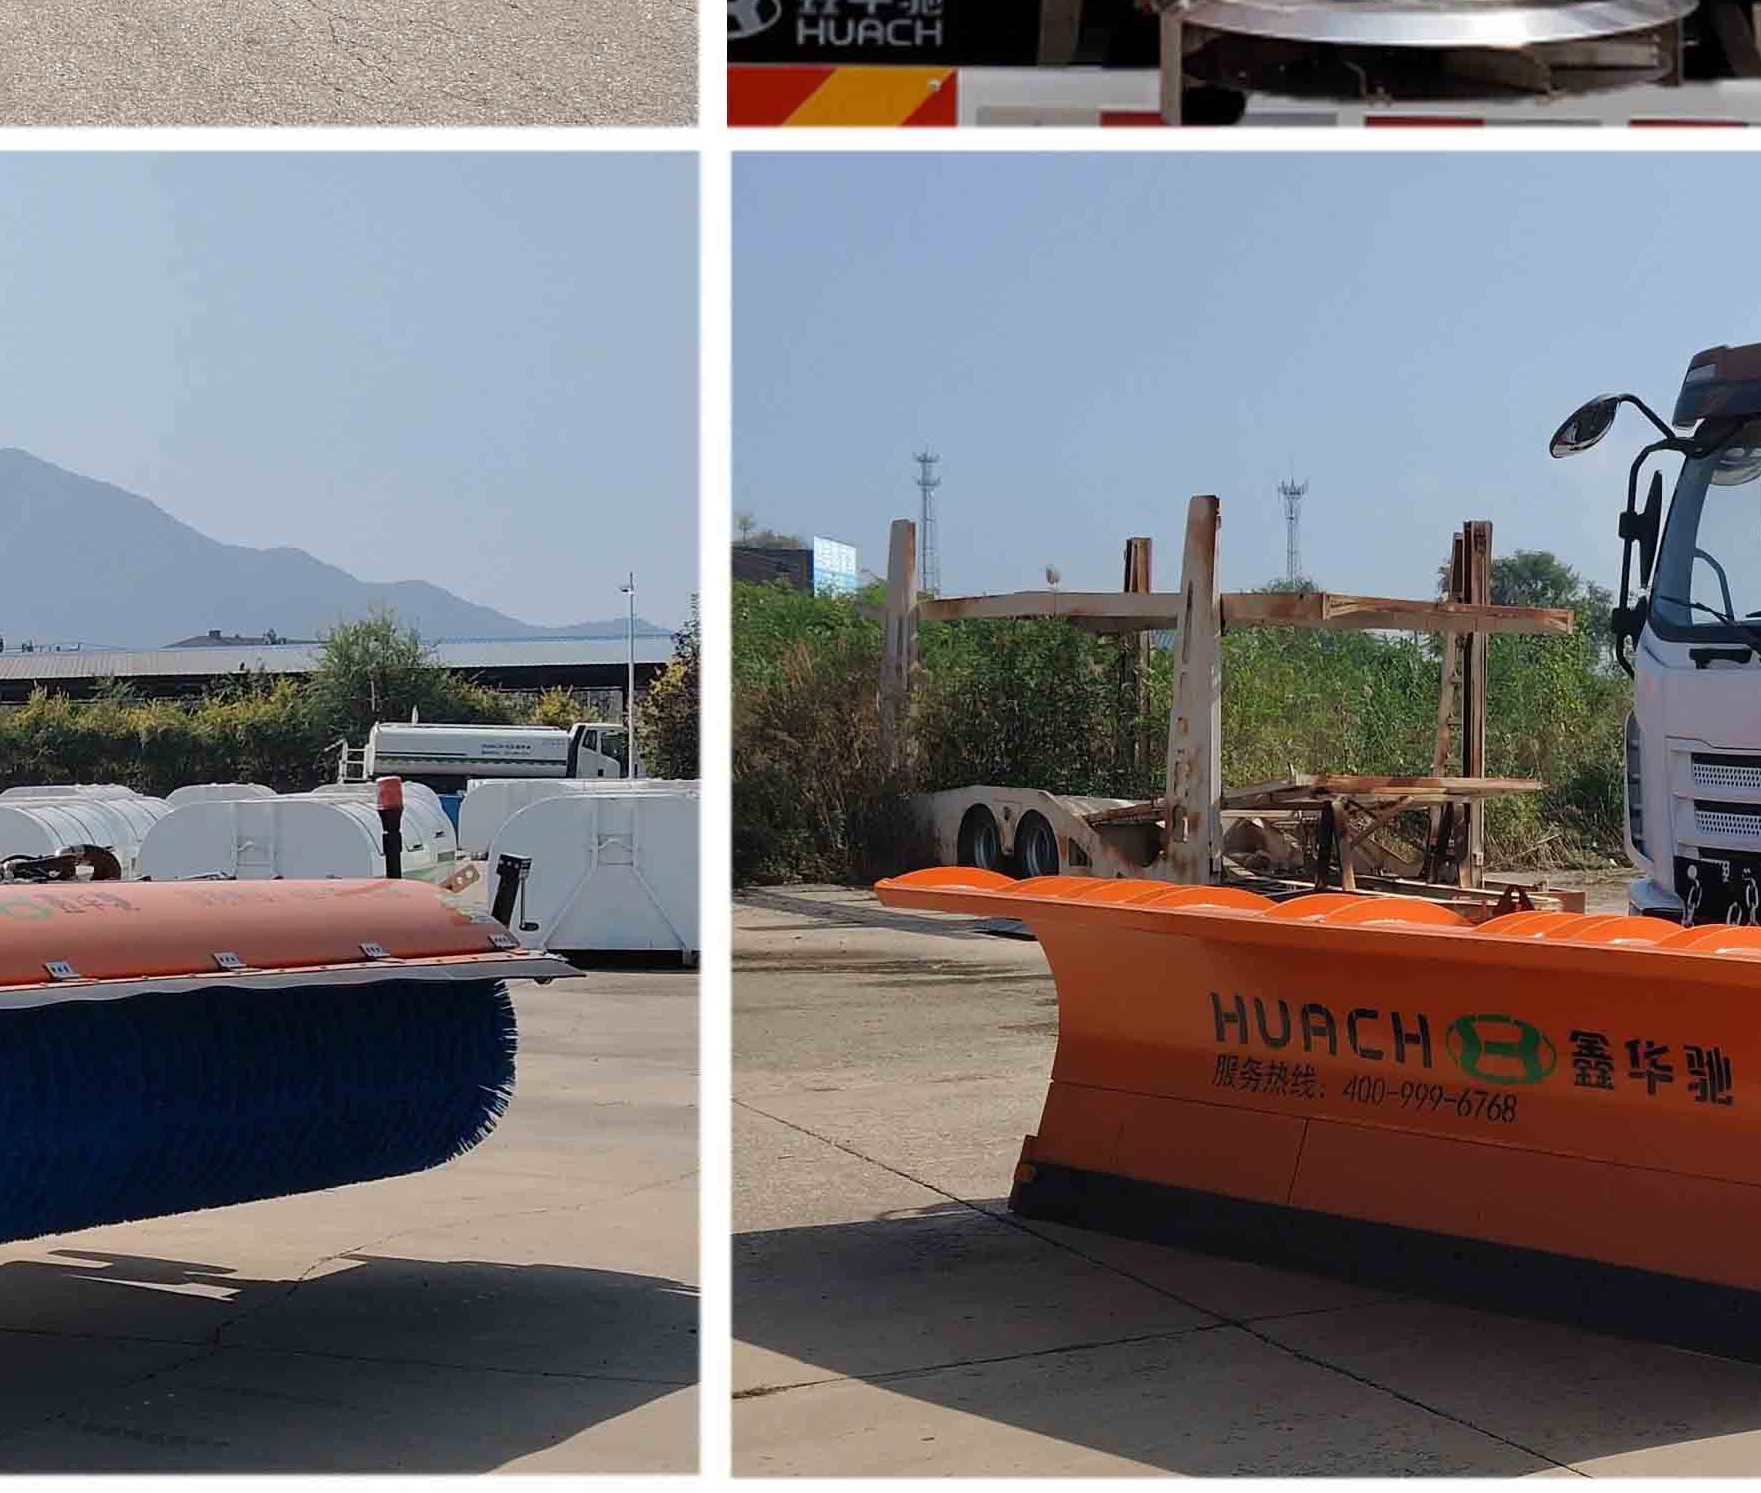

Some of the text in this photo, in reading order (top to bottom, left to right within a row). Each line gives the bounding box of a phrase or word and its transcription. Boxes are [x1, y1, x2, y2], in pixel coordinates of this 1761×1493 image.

[796, 17, 943, 46] HUACH
[1210, 991, 1433, 1069] HUACH
[1341, 1074, 1518, 1123] 400-999-6768
[1569, 1029, 1735, 1106] 鑫华驰
